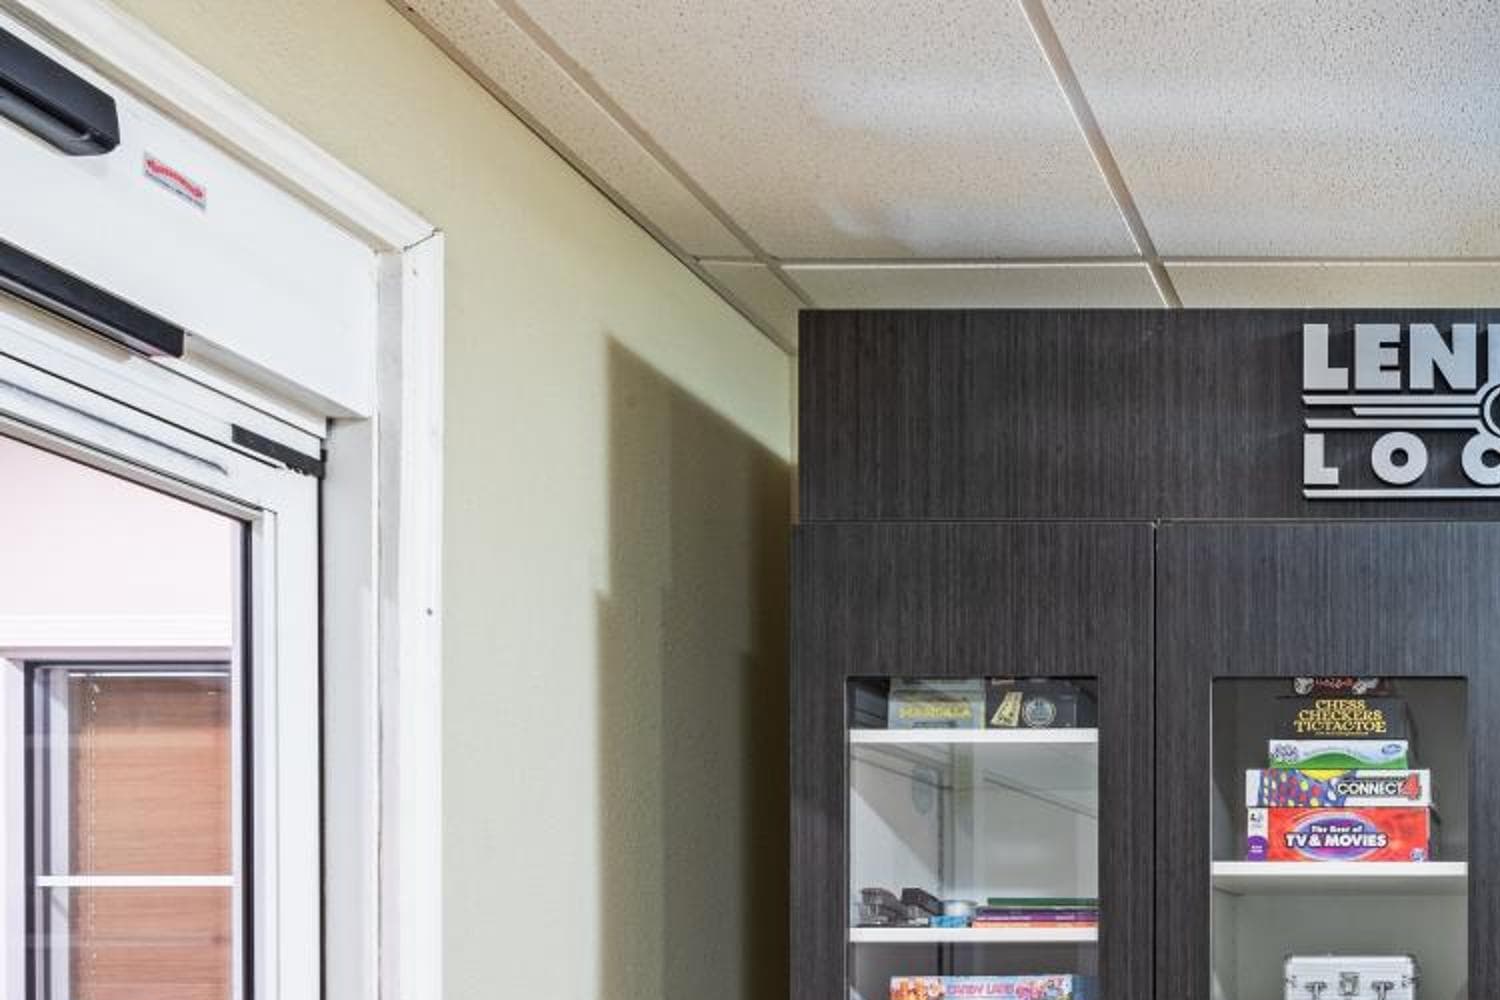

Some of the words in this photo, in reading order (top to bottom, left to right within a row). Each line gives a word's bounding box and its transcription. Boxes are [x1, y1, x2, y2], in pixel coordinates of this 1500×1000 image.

[1315, 699, 1365, 710] CHESS
[1299, 709, 1382, 721] CHECKERS
[1337, 782, 1401, 796] CONNECT
[1401, 773, 1421, 800] 4
[1286, 833, 1309, 847] TV
[1309, 833, 1321, 847] &
[1324, 833, 1387, 847] MOVIES
